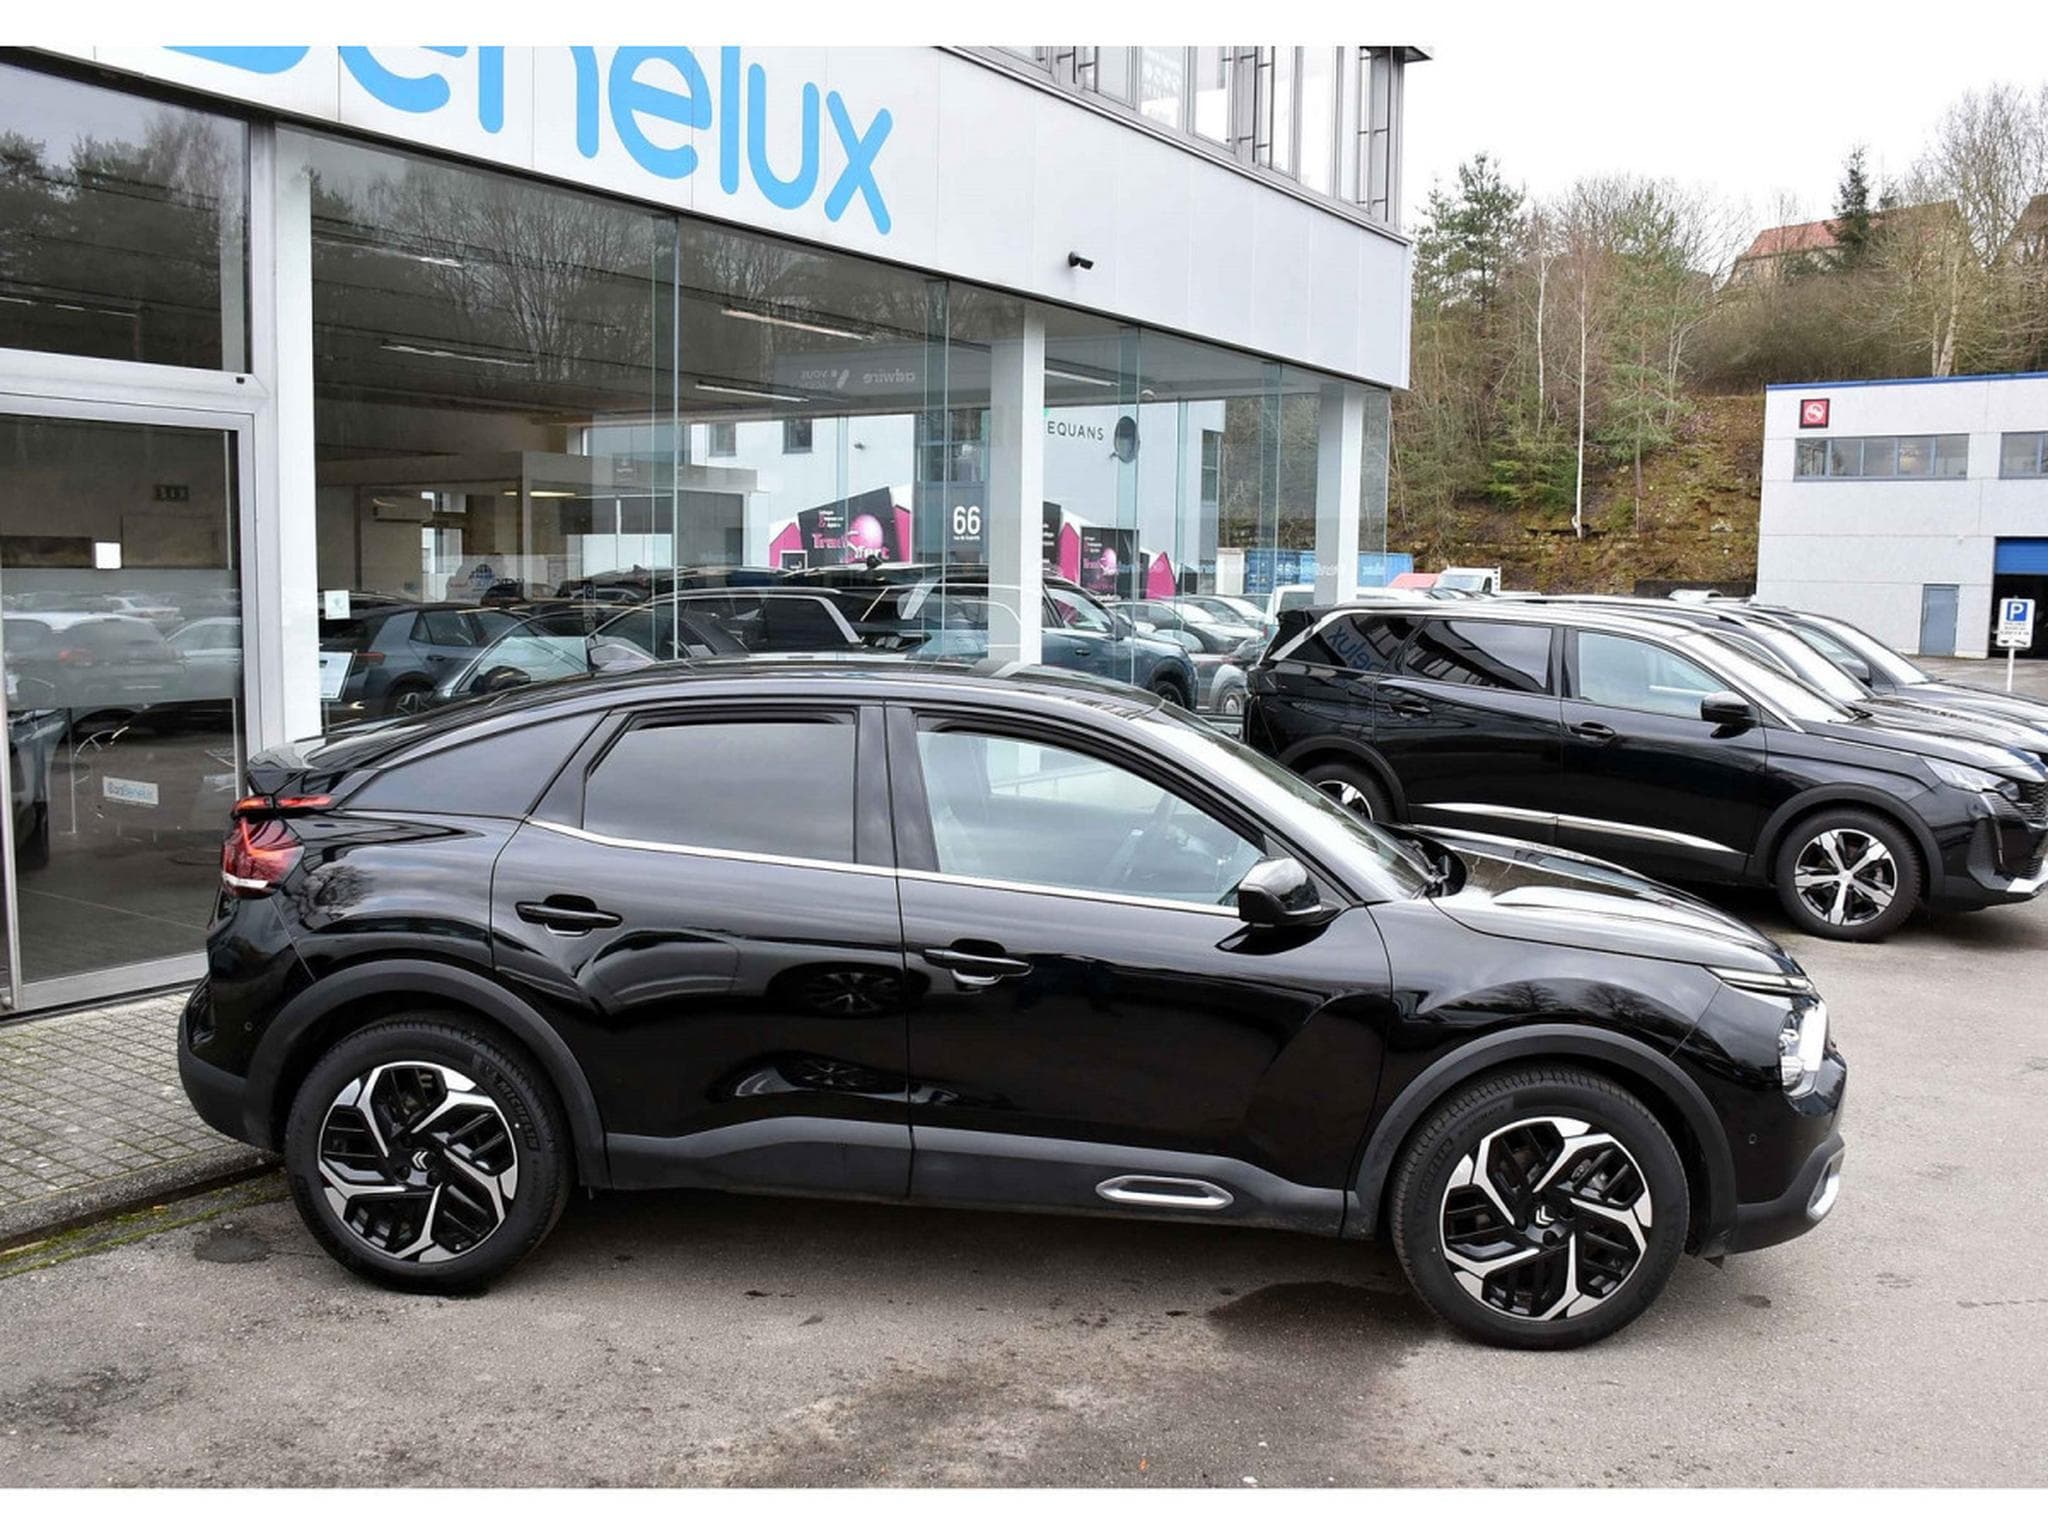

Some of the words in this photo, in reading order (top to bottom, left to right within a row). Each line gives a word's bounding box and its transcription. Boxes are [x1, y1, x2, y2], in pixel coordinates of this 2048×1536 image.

[168, 46, 891, 233] nelux
[1047, 420, 1104, 440] EQUANS
[953, 505, 981, 534] 66
[2009, 602, 2025, 620] P
